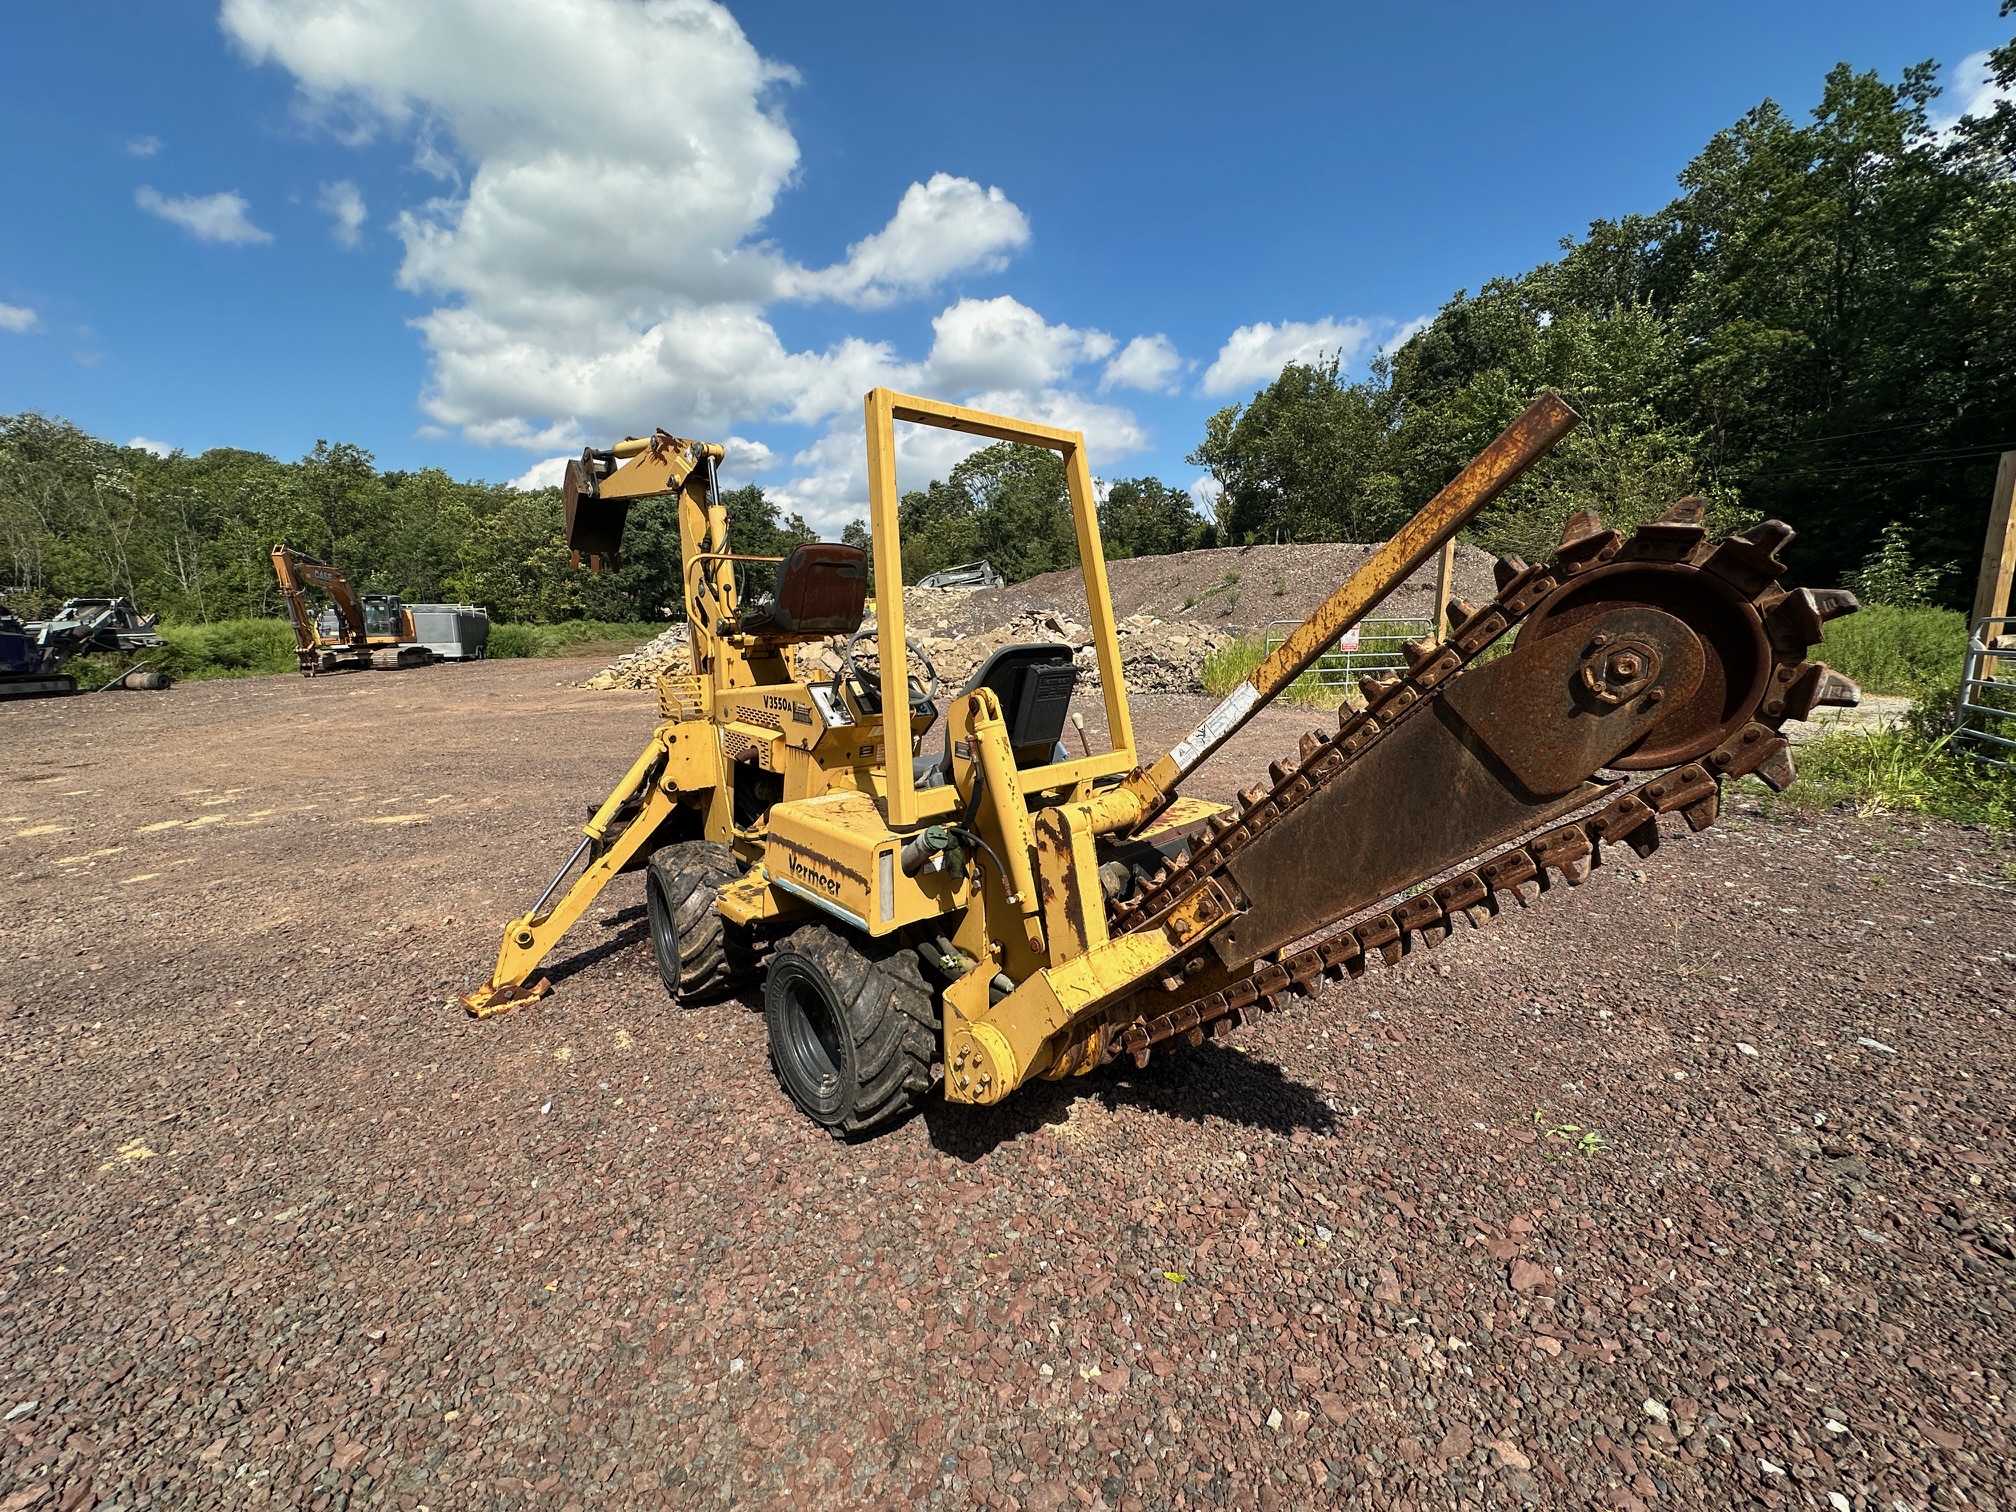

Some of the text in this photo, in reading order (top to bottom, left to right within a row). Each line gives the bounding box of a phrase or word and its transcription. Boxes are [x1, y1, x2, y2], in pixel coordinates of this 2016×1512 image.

[314, 570, 333, 581] CASE
[763, 695, 792, 712] V3550A
[788, 853, 841, 898] Vermeer
[770, 977, 783, 1033] GUARD
